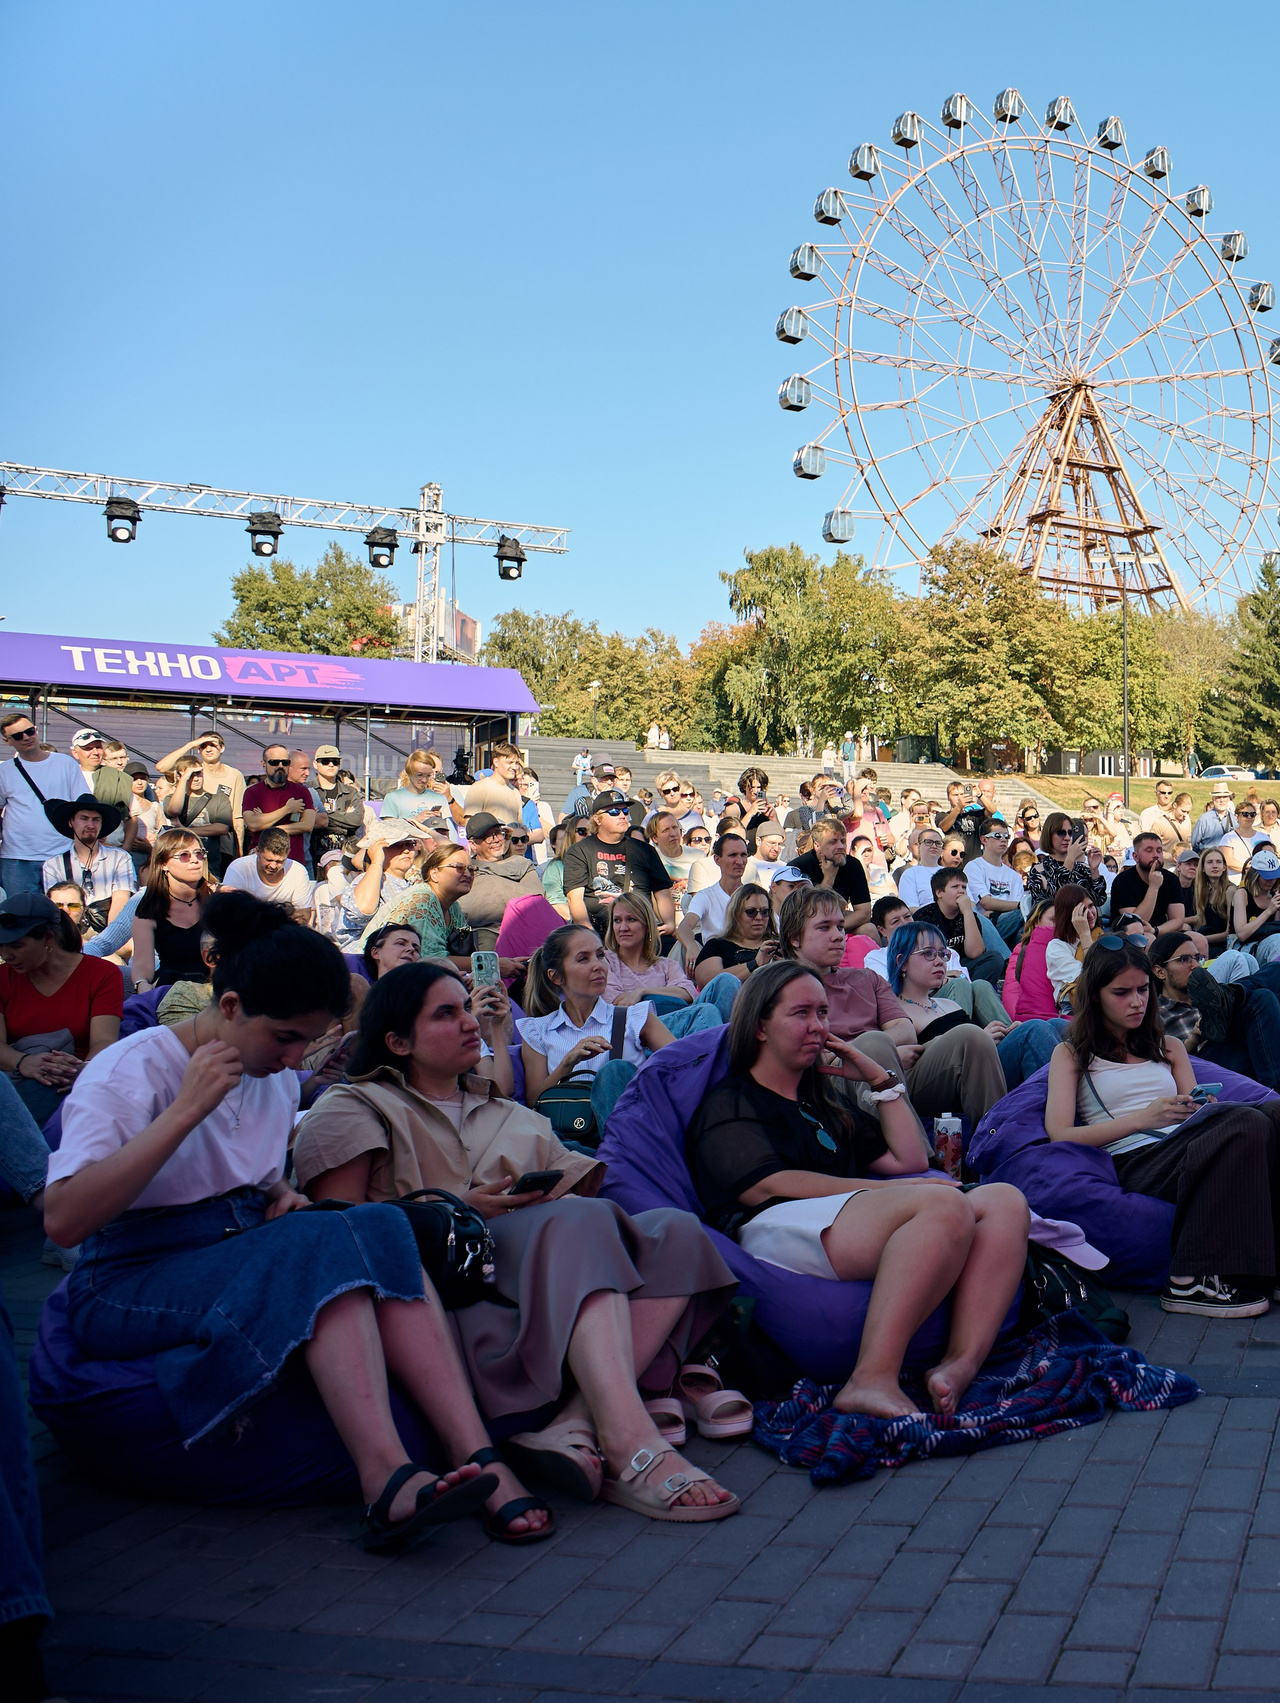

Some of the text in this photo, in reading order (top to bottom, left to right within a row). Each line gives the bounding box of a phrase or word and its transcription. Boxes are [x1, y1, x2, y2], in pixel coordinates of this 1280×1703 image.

[60, 645, 320, 685] ТЕХНО АРТ
[1267, 858, 1276, 869] NY
